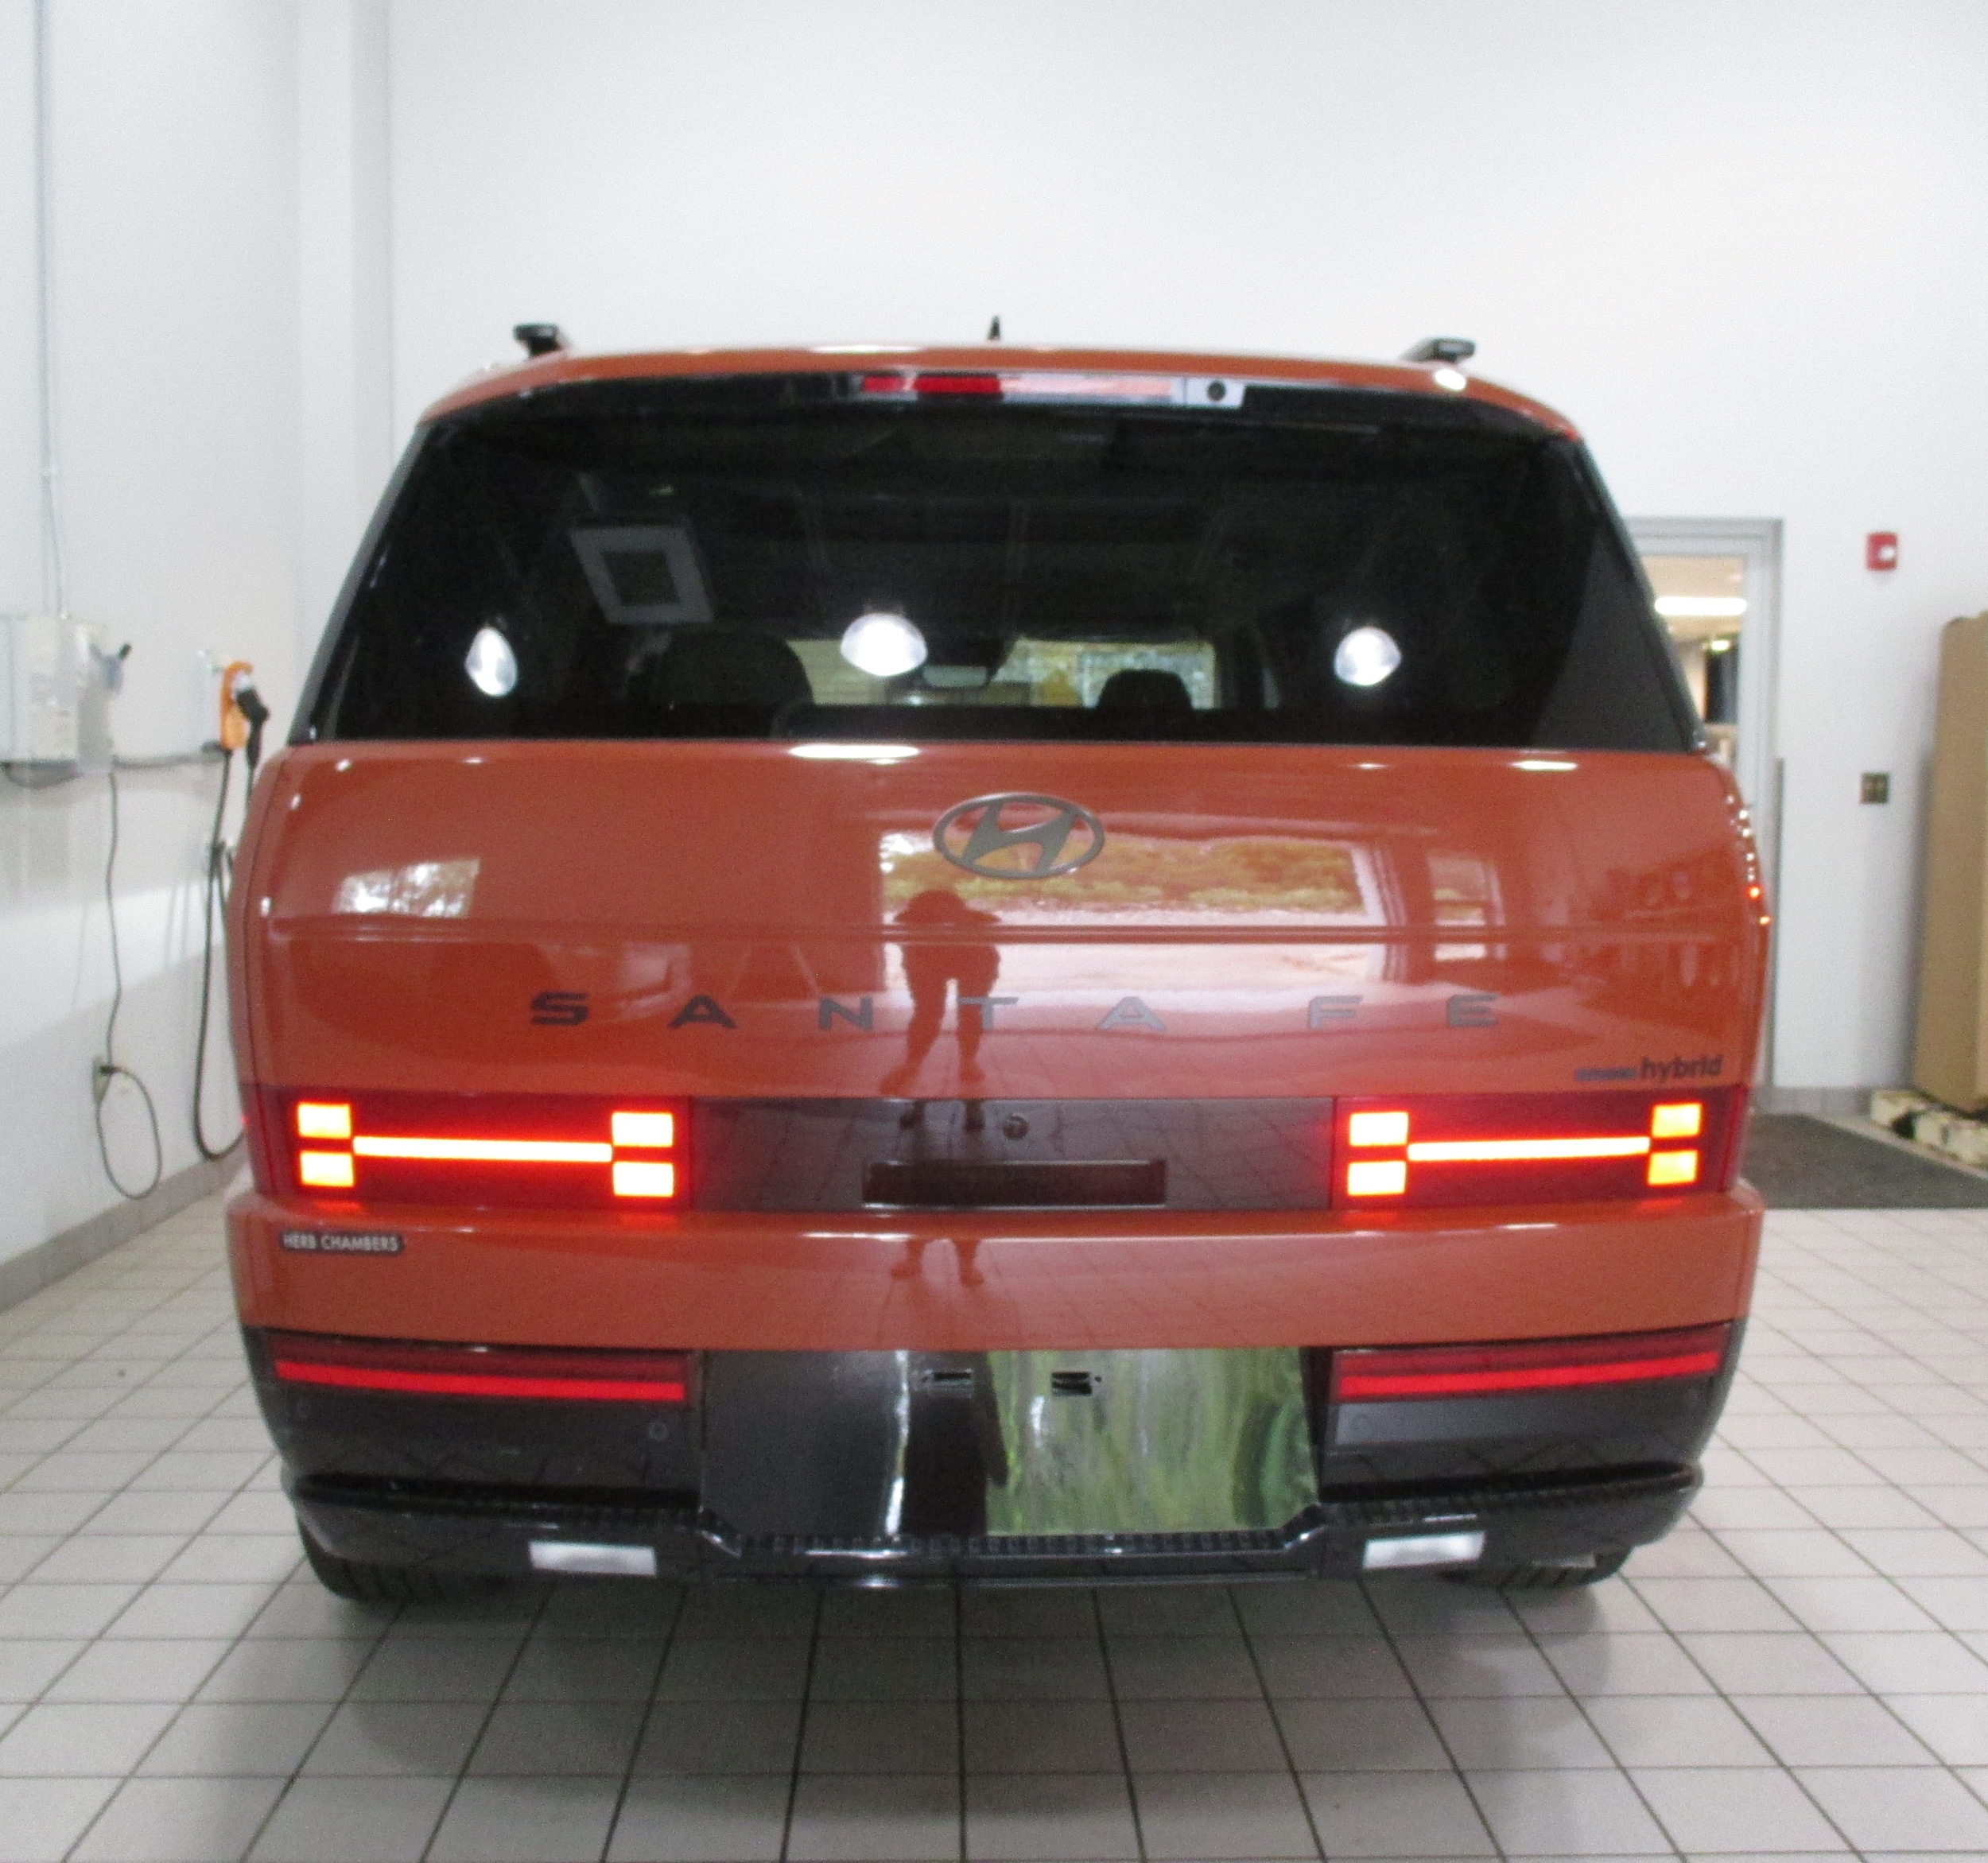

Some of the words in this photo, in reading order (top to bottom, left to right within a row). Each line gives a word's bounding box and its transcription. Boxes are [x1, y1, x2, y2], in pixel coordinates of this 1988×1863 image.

[531, 991, 1167, 1031] SANTA
[1308, 993, 1499, 1029] FE
[1641, 1054, 1724, 1084] hybrid
[283, 1232, 316, 1250] HERB
[321, 1234, 398, 1252] CHAMBERS
